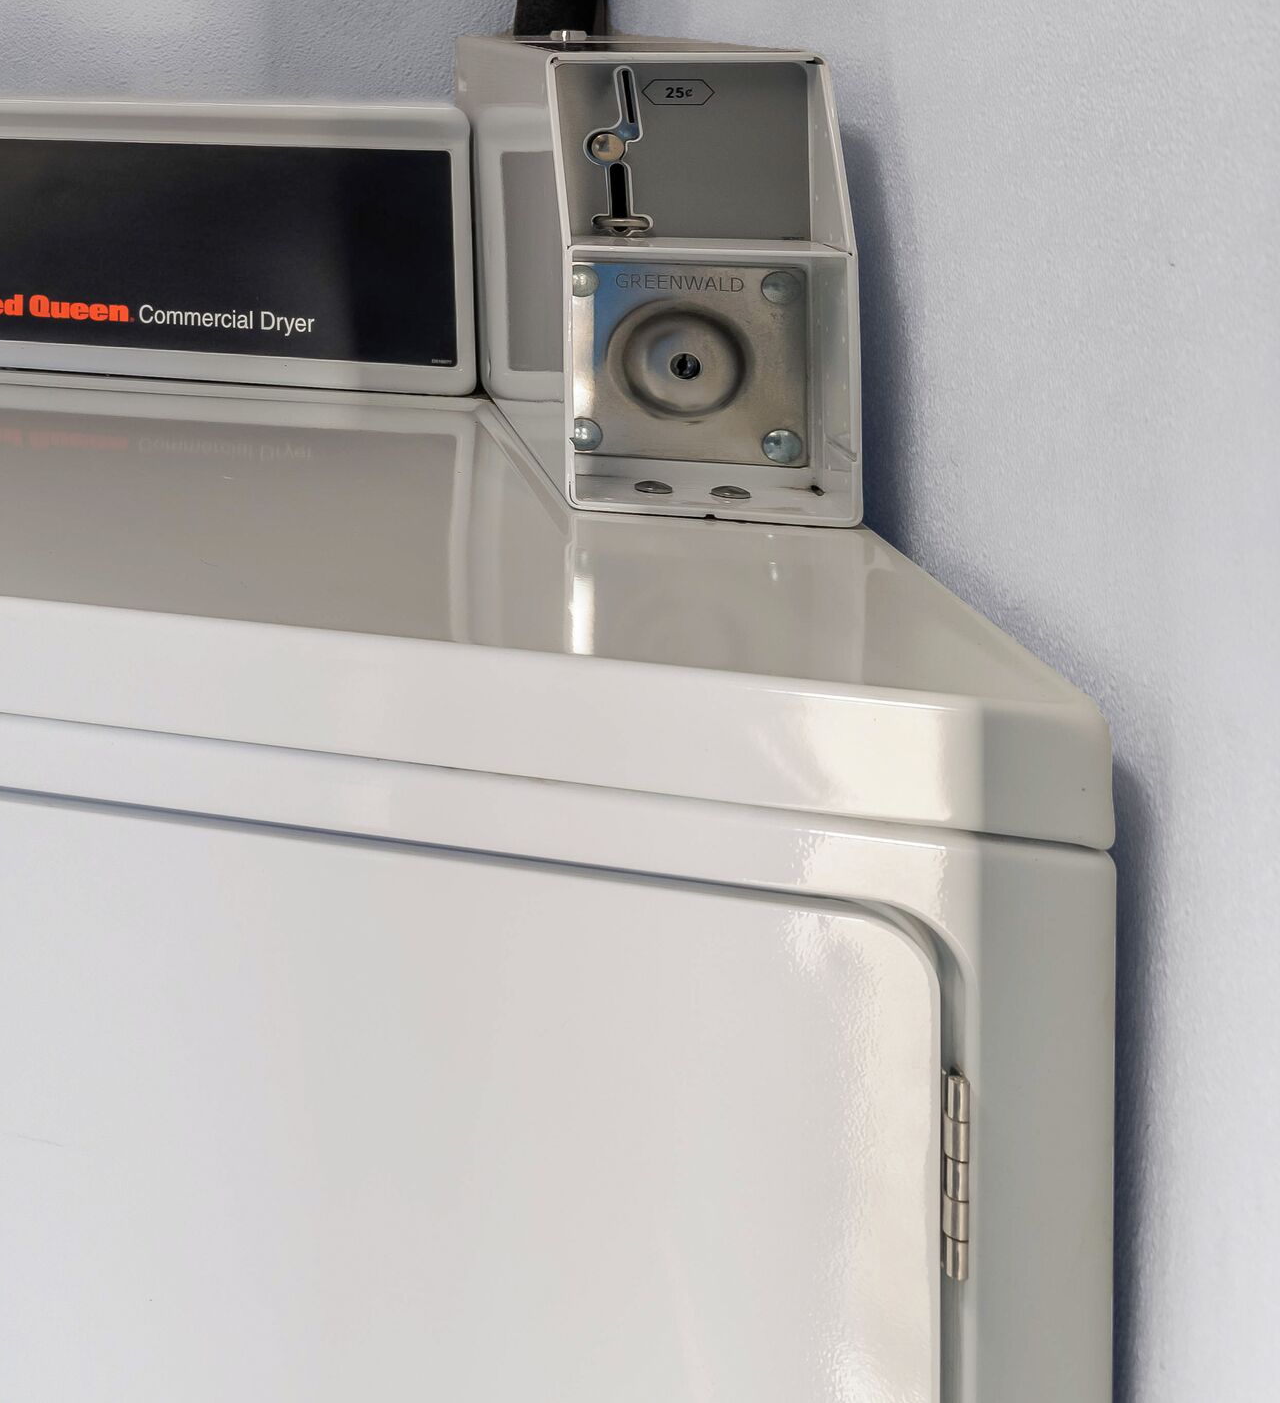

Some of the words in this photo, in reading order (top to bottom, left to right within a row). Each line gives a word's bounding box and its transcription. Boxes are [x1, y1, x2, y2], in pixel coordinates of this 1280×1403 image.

[665, 87, 693, 99] 25¢
[615, 273, 745, 293] GREENWALD
[29, 294, 130, 322] Queen
[139, 304, 253, 329] Commercial
[260, 311, 315, 337] Dryer
